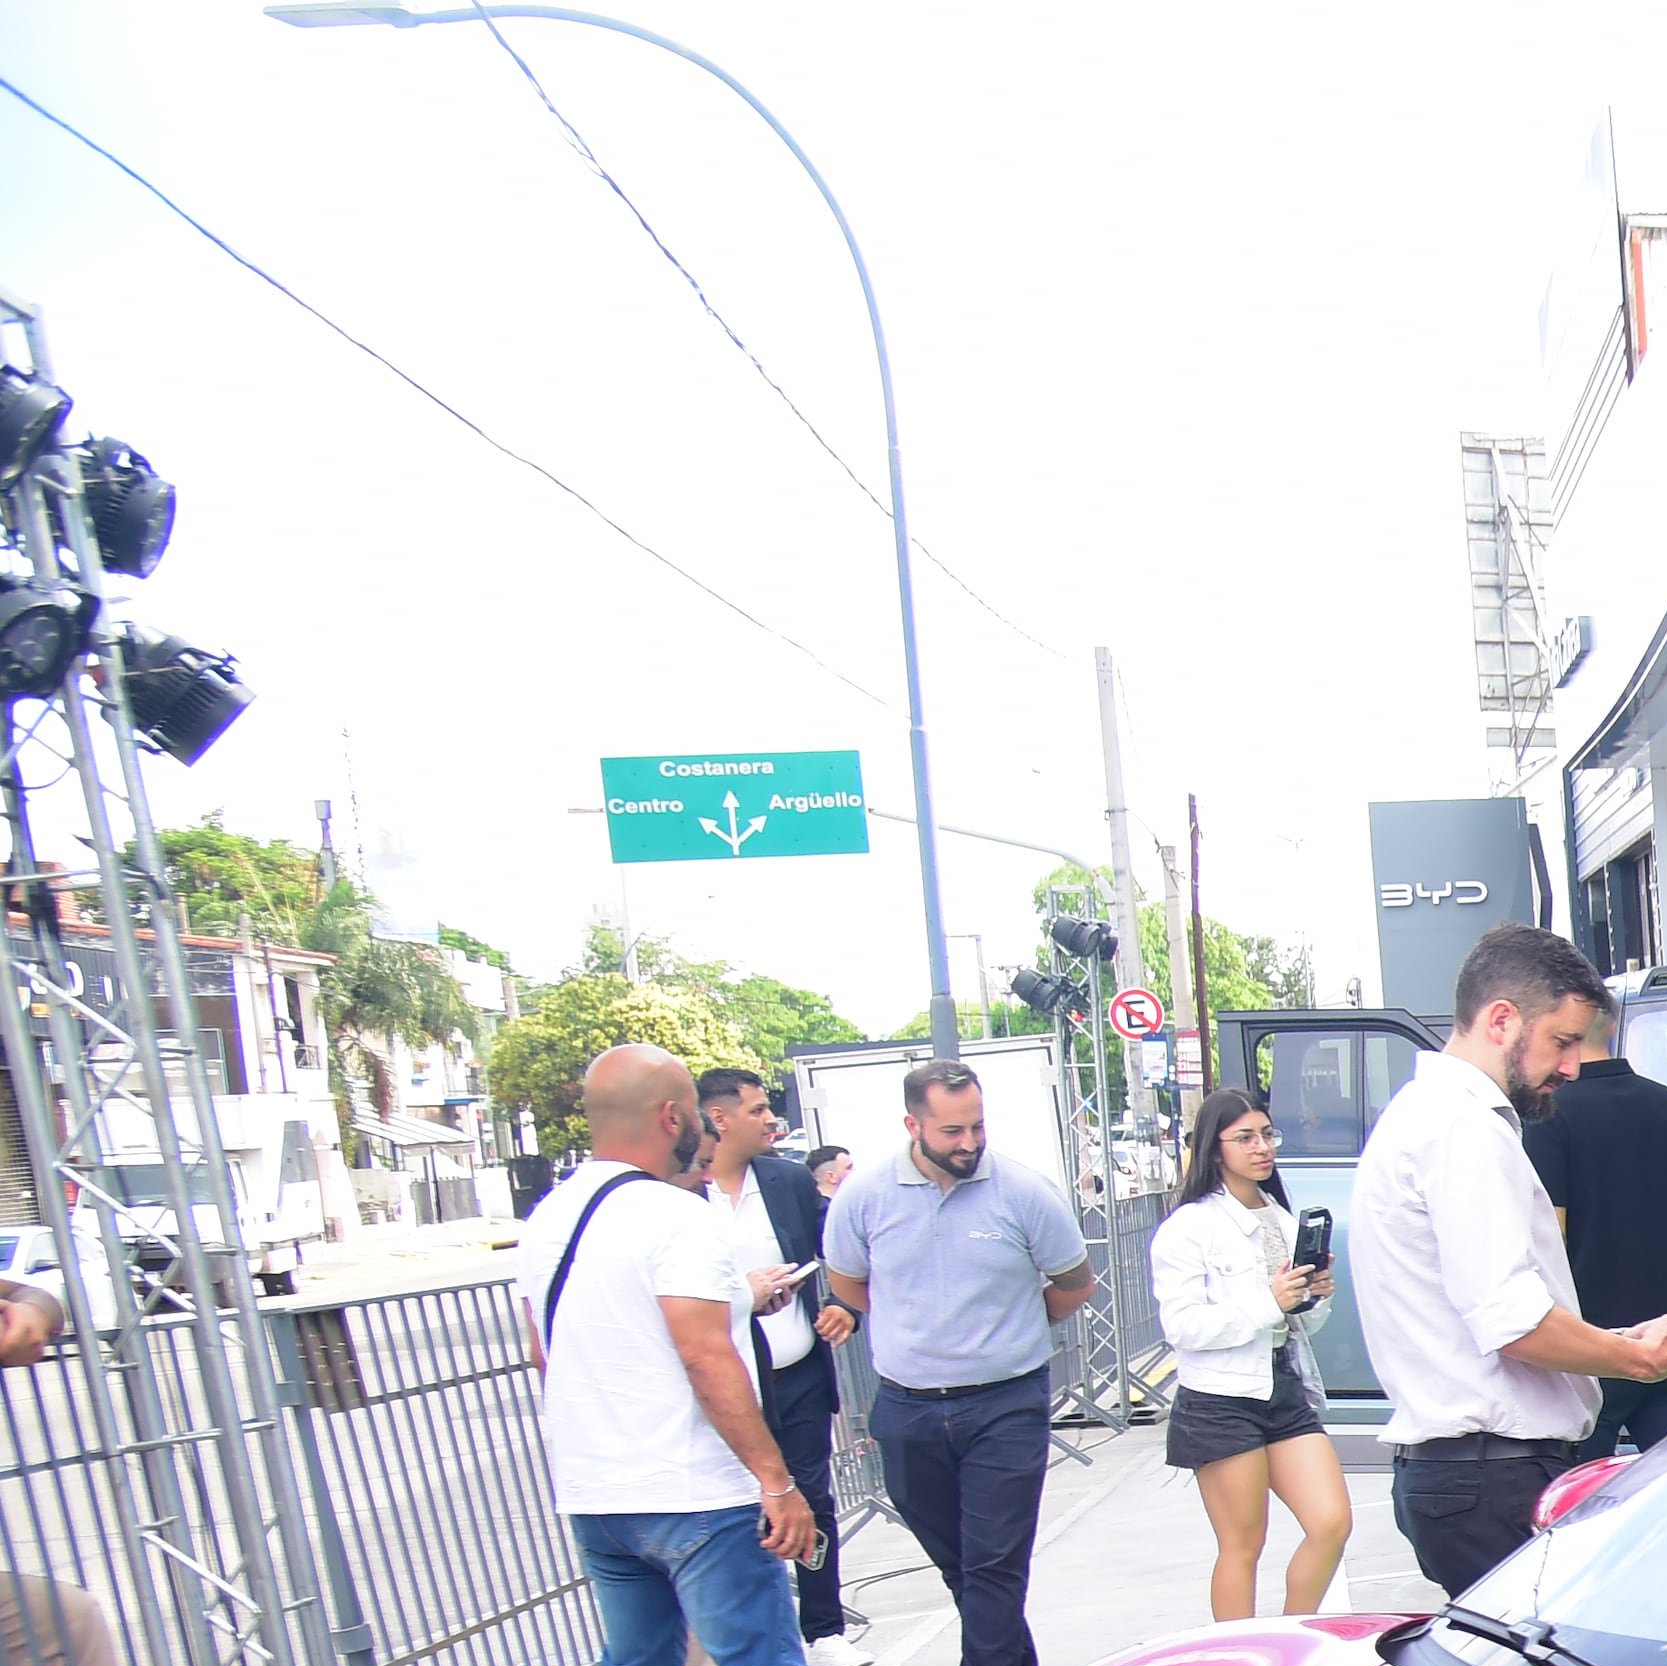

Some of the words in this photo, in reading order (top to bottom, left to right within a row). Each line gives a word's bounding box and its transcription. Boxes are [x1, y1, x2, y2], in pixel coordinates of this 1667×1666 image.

[659, 760, 775, 778] Costanera
[608, 798, 685, 814] Centro
[769, 792, 863, 813] Argüello
[1380, 880, 1488, 907] BYD
